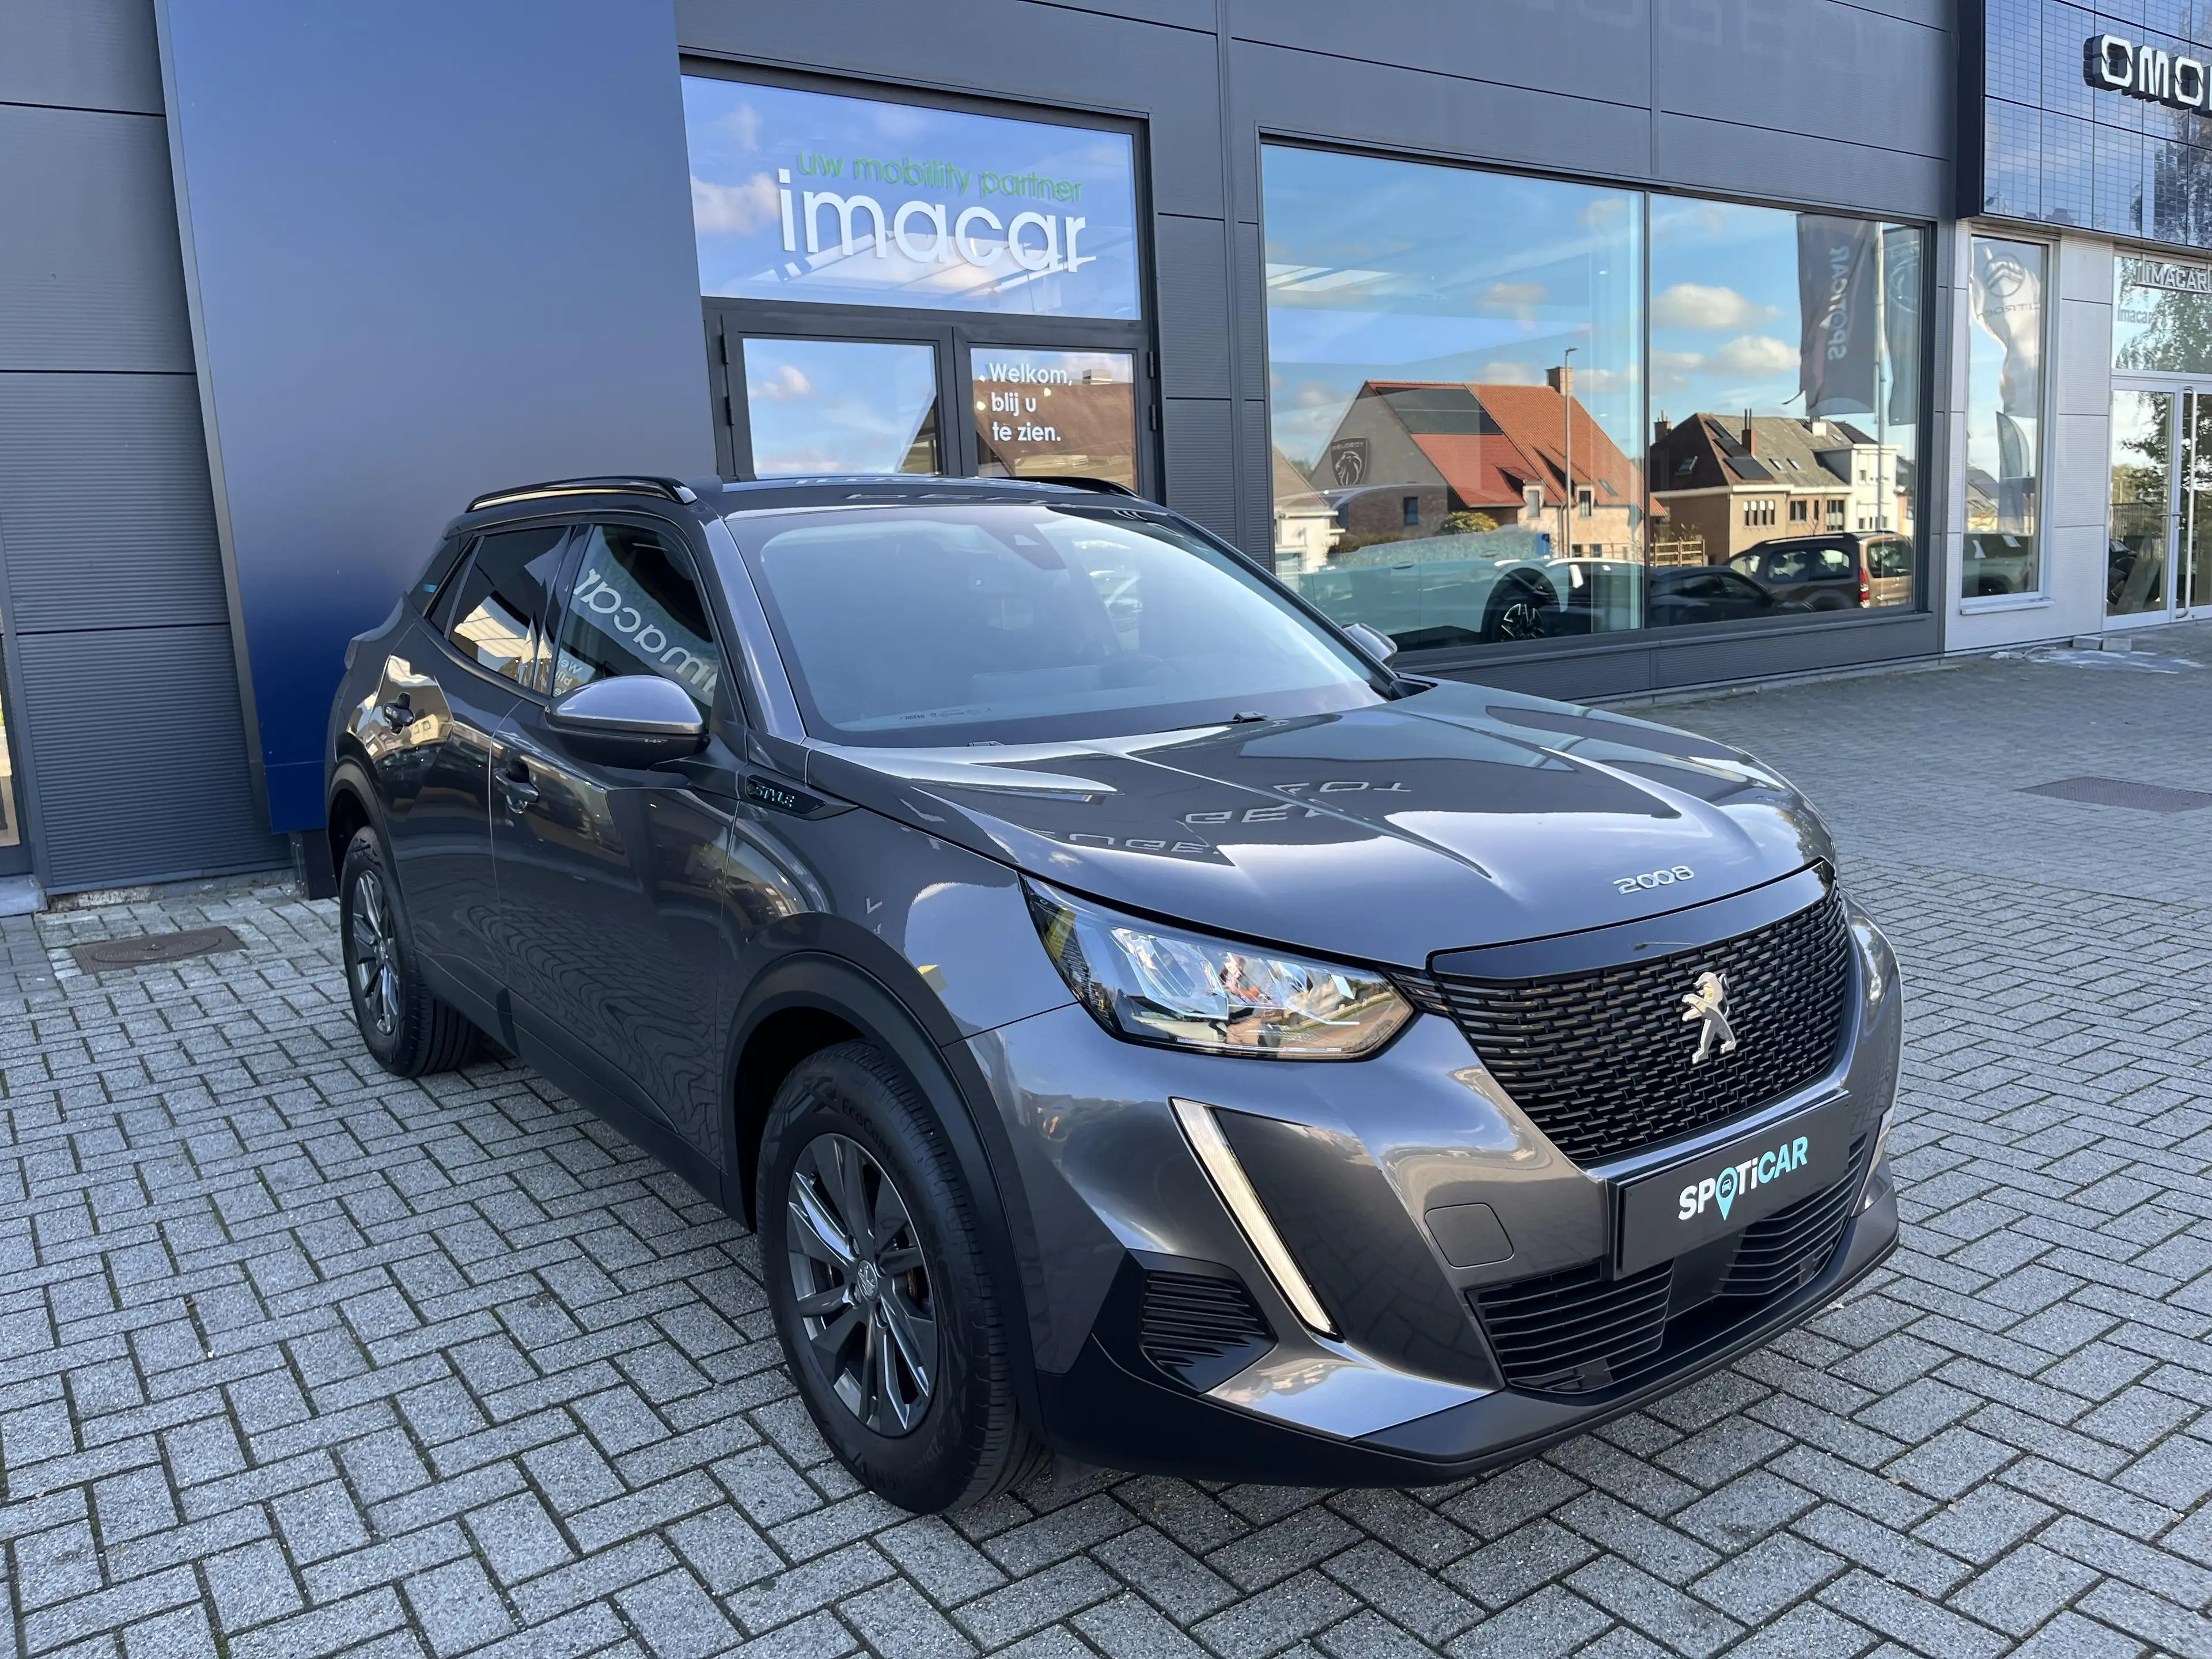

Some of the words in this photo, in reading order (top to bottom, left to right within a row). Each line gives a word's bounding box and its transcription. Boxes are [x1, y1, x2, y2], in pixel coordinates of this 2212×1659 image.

[2101, 34, 2212, 109] OMO
[797, 152, 844, 176] uw
[853, 156, 971, 196] mobility
[980, 171, 1082, 202] partner
[778, 168, 1086, 273] imacar
[2146, 264, 2208, 291] IMACAR
[989, 363, 1073, 387] Welkom,
[991, 392, 1020, 416] blij
[1025, 397, 1036, 412] u
[992, 422, 1012, 441] te
[1017, 422, 1061, 442] zien.
[1613, 866, 1694, 895] 2008
